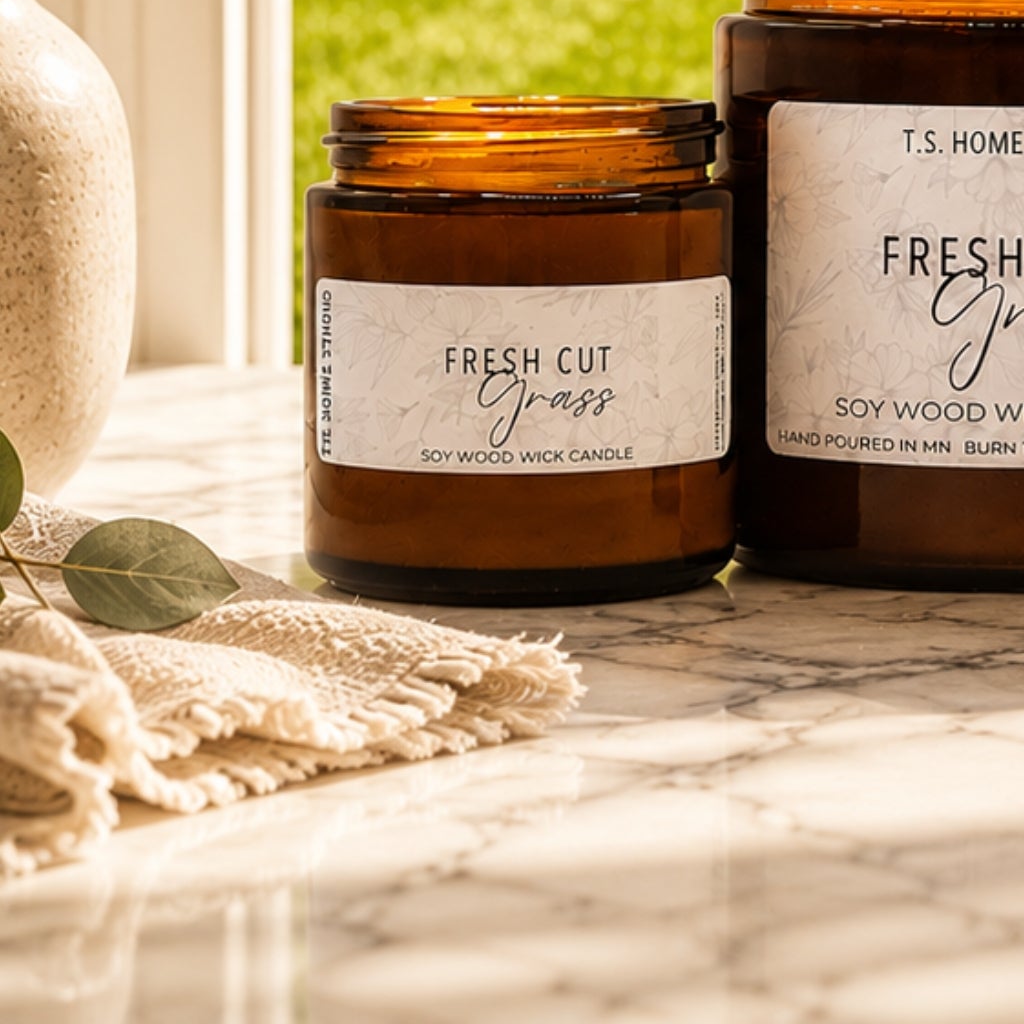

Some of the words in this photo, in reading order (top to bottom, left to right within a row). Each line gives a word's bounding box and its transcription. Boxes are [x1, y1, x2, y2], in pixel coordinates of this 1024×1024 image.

[903, 130, 943, 153] T.S.
[953, 131, 1022, 154] HOME
[883, 236, 1022, 277] FRESH
[445, 347, 540, 374] FRESH
[557, 347, 611, 374] CUT
[836, 398, 885, 418] SOY
[894, 402, 986, 422] WOOD
[779, 430, 820, 446] HAND
[825, 434, 894, 451] POURED
[900, 440, 917, 452] IN
[923, 441, 951, 453] MN
[965, 442, 1016, 455] BURN
[421, 448, 453, 463] SOY
[458, 450, 514, 464] WOOD
[521, 450, 564, 463] WICK
[570, 447, 633, 462] CANDLE
